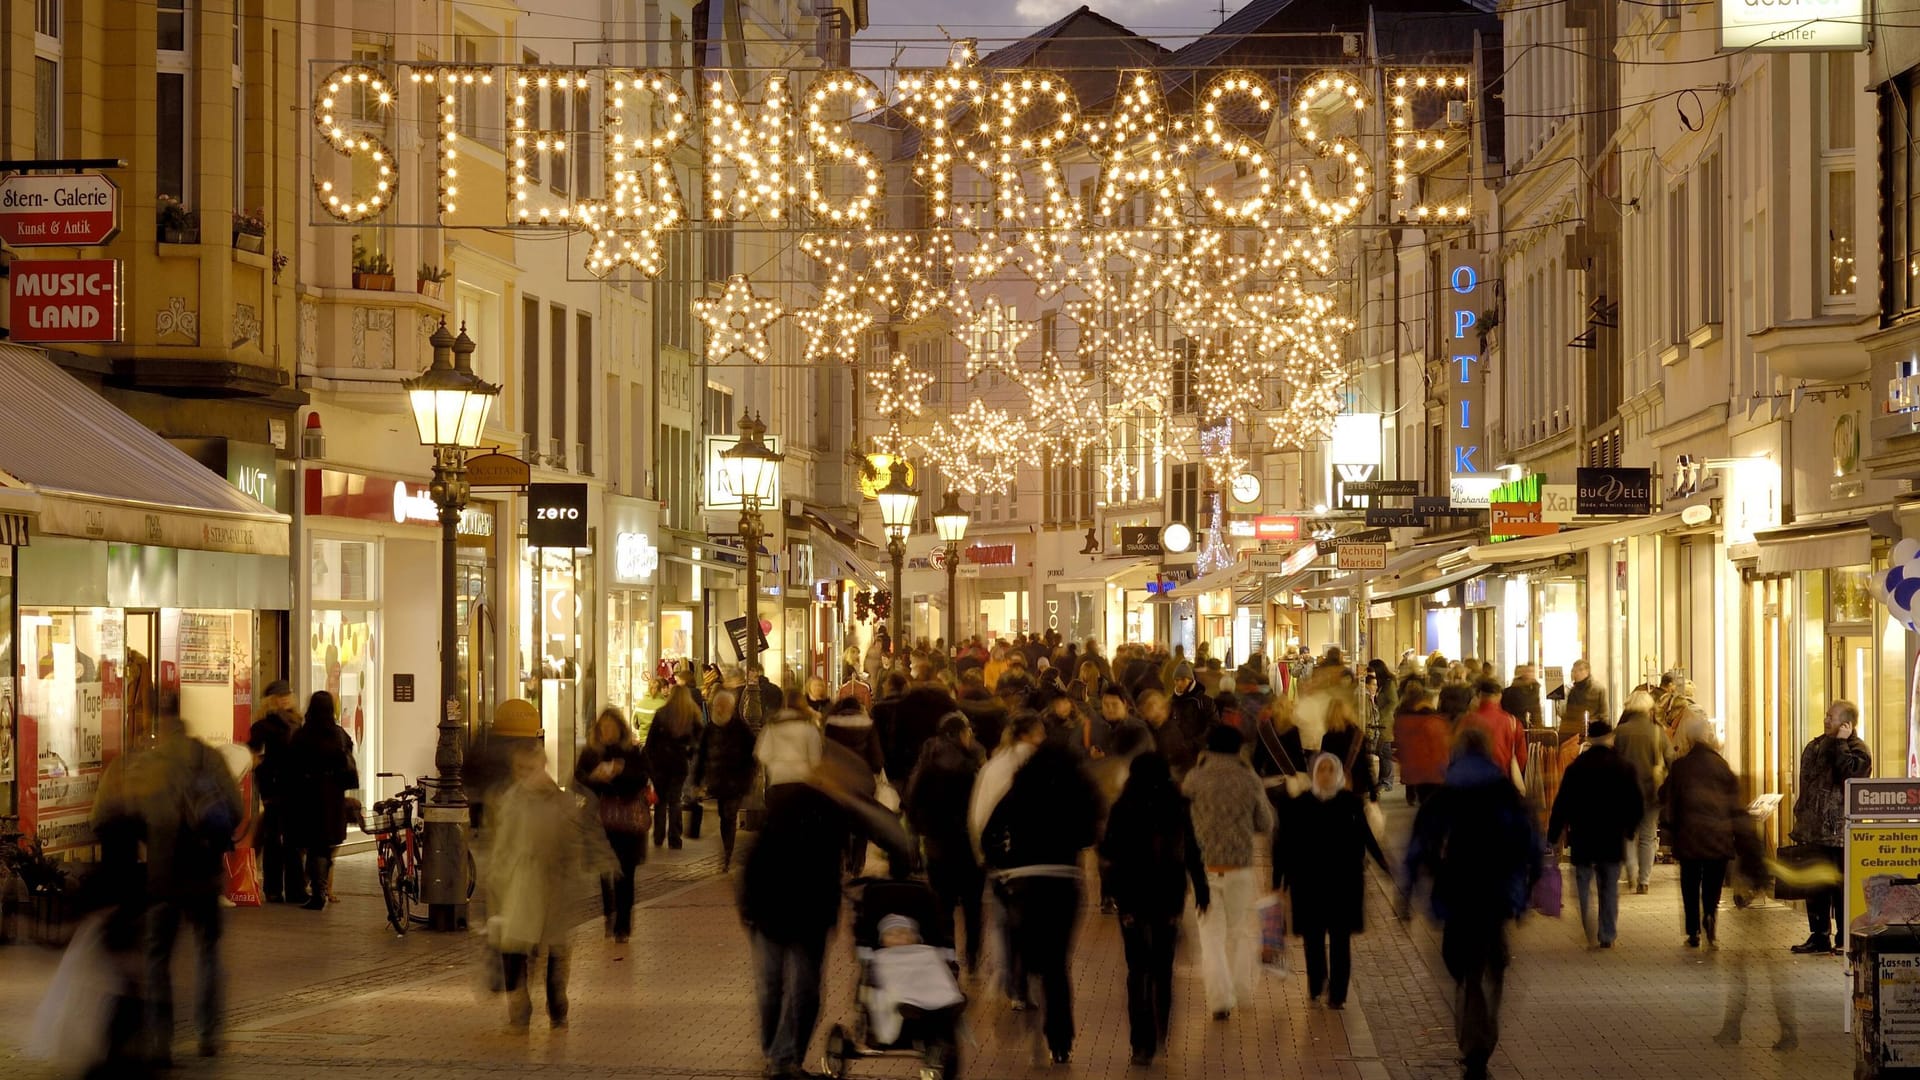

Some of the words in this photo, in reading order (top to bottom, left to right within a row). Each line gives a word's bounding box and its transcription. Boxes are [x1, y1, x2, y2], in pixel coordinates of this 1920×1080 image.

[1771, 29, 1816, 40] center
[314, 64, 1470, 222] STERNSTRASSE
[3, 187, 49, 208] Stern-
[54, 187, 107, 207] Galerie
[17, 221, 46, 235] Kunst
[50, 220, 60, 235] &
[64, 219, 91, 234] Antik
[16, 273, 112, 297] MUSIC-
[28, 305, 100, 329] LAND
[1451, 265, 1479, 472] OPTIK
[238, 465, 267, 504] AUST
[1347, 482, 1378, 490] STERN
[537, 508, 578, 520] zero
[1127, 543, 1159, 551] SWAROVSKI
[1340, 546, 1382, 557] Achtung
[1340, 558, 1382, 567] Markise
[83, 689, 101, 713] Tage
[83, 728, 101, 753] Tage
[1858, 787, 1920, 805] GameS
[1853, 833, 1875, 841] Wir
[1879, 832, 1918, 841] zahlen
[1878, 845, 1896, 854] für
[1881, 957, 1911, 967] Lassen
[1881, 969, 1894, 980] Ihr
